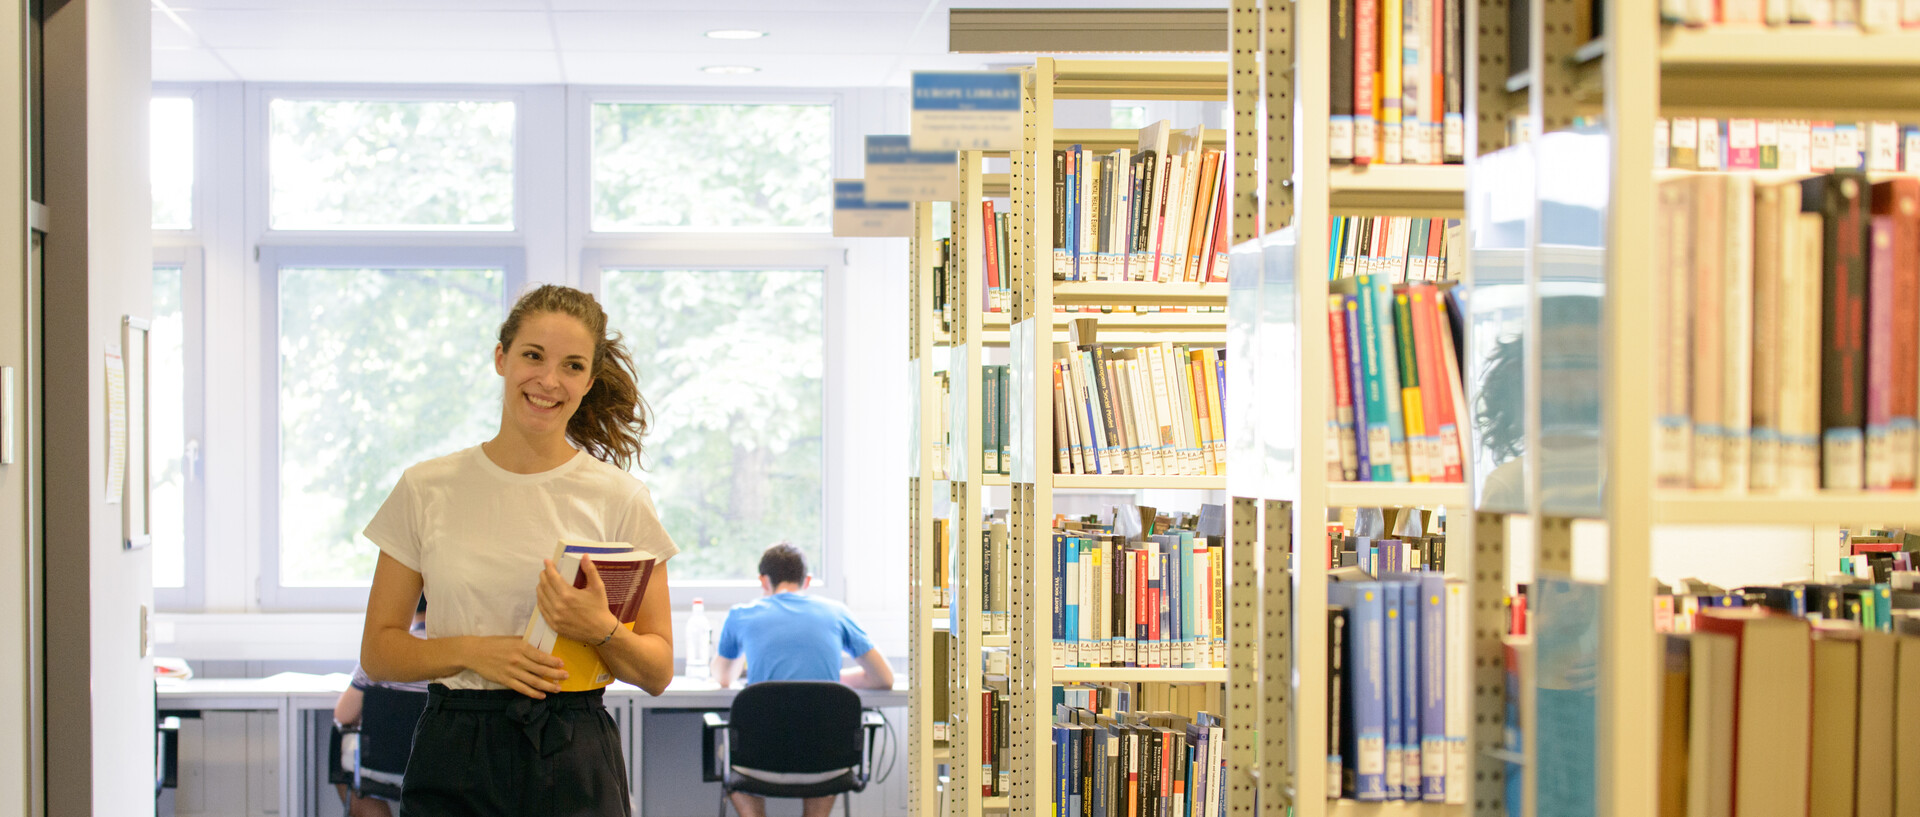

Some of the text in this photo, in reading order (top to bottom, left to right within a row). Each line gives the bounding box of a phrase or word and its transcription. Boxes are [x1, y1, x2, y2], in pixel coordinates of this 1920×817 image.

[916, 88, 1017, 98] EUROPE LIBRARY
[1098, 360, 1106, 388] European
[1102, 391, 1110, 408] Social
[1106, 410, 1114, 428] Model
